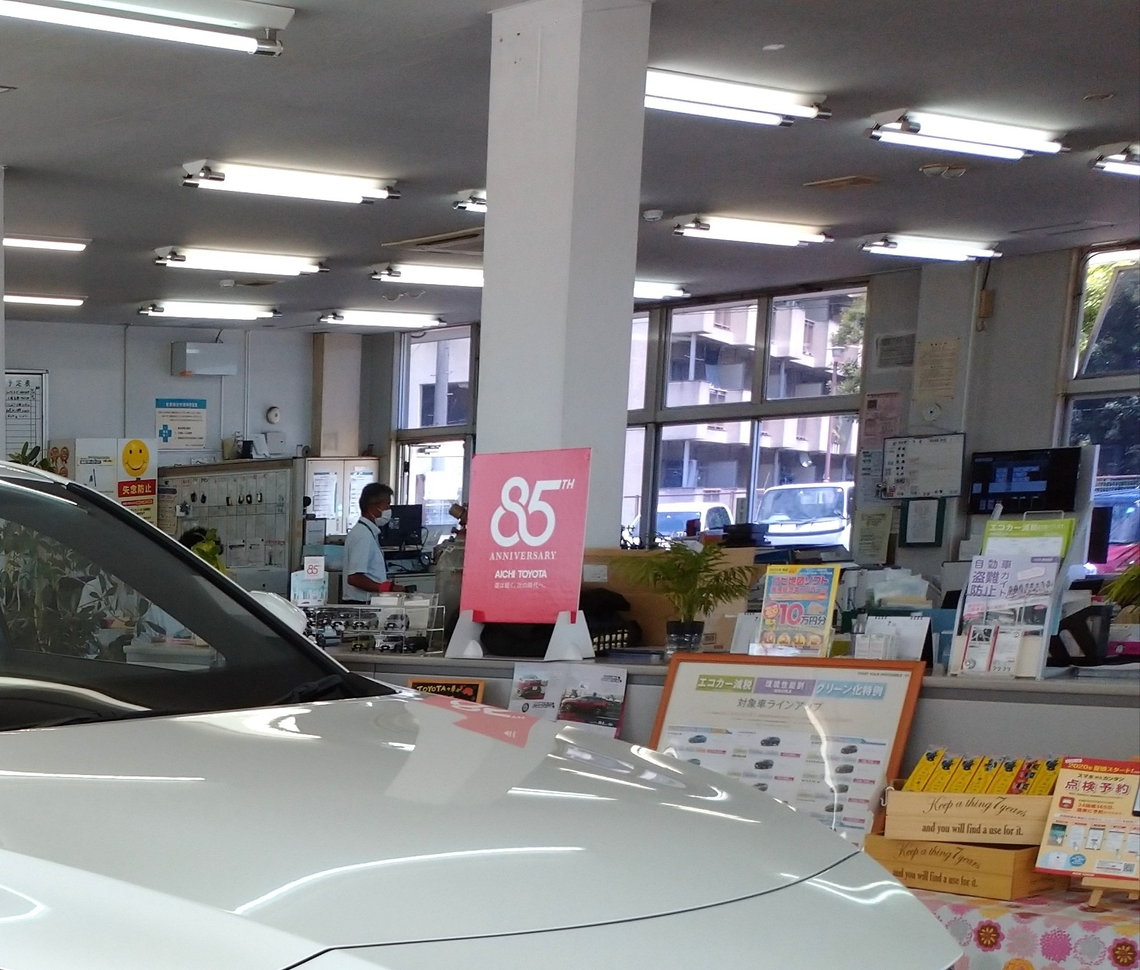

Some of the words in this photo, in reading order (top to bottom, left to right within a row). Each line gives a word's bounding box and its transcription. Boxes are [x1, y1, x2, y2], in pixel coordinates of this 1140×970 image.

[489, 551, 557, 561] ANNIVERSARY
[974, 560, 1012, 570] 自動車
[494, 570, 516, 579] AICHI
[518, 569, 547, 579] TOYOTA
[696, 676, 753, 690] エコカー減税
[816, 682, 884, 698] クリーン化特例
[1065, 779, 1131, 796] 点検予約
[964, 798, 992, 813] thing
[922, 822, 936, 832] and
[937, 824, 950, 835] you
[951, 823, 965, 833] will
[966, 823, 981, 834] find
[989, 827, 1002, 835] use
[1003, 823, 1014, 835] for
